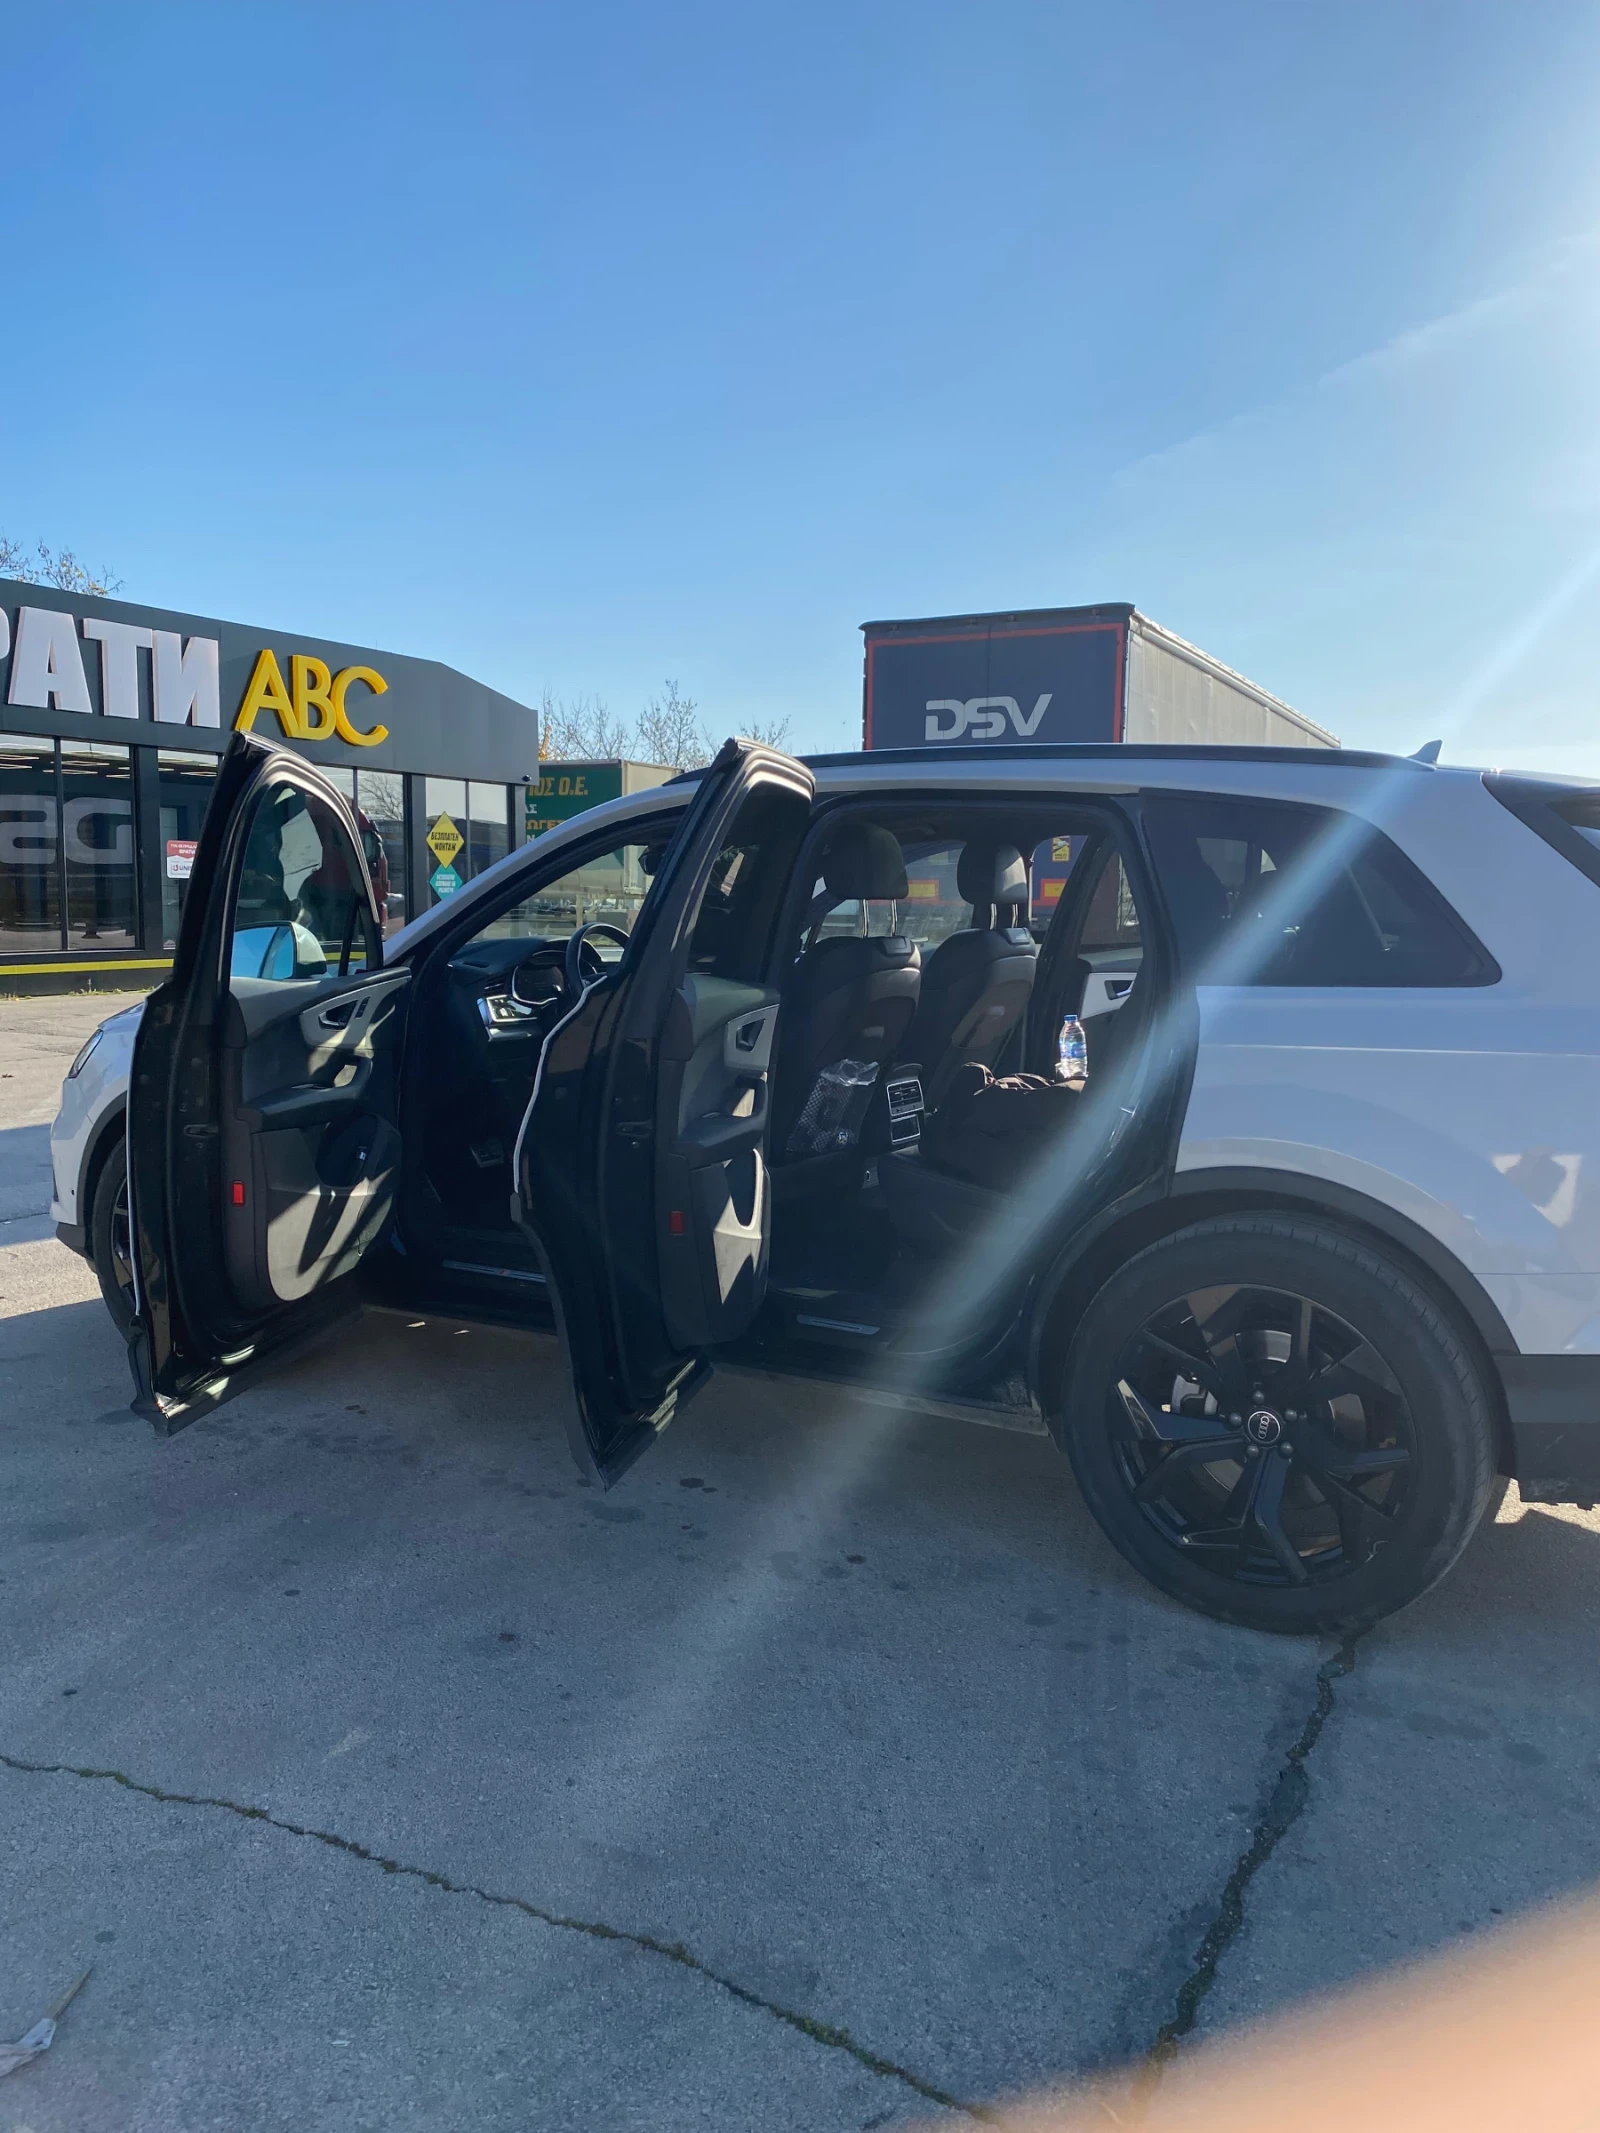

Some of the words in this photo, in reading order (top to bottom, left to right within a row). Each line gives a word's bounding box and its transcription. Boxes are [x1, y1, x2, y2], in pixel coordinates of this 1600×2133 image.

[0, 606, 220, 729] АТИ
[234, 648, 389, 747] ABC
[925, 693, 1053, 741] DSV
[434, 842, 457, 852] МОНТАЖ
